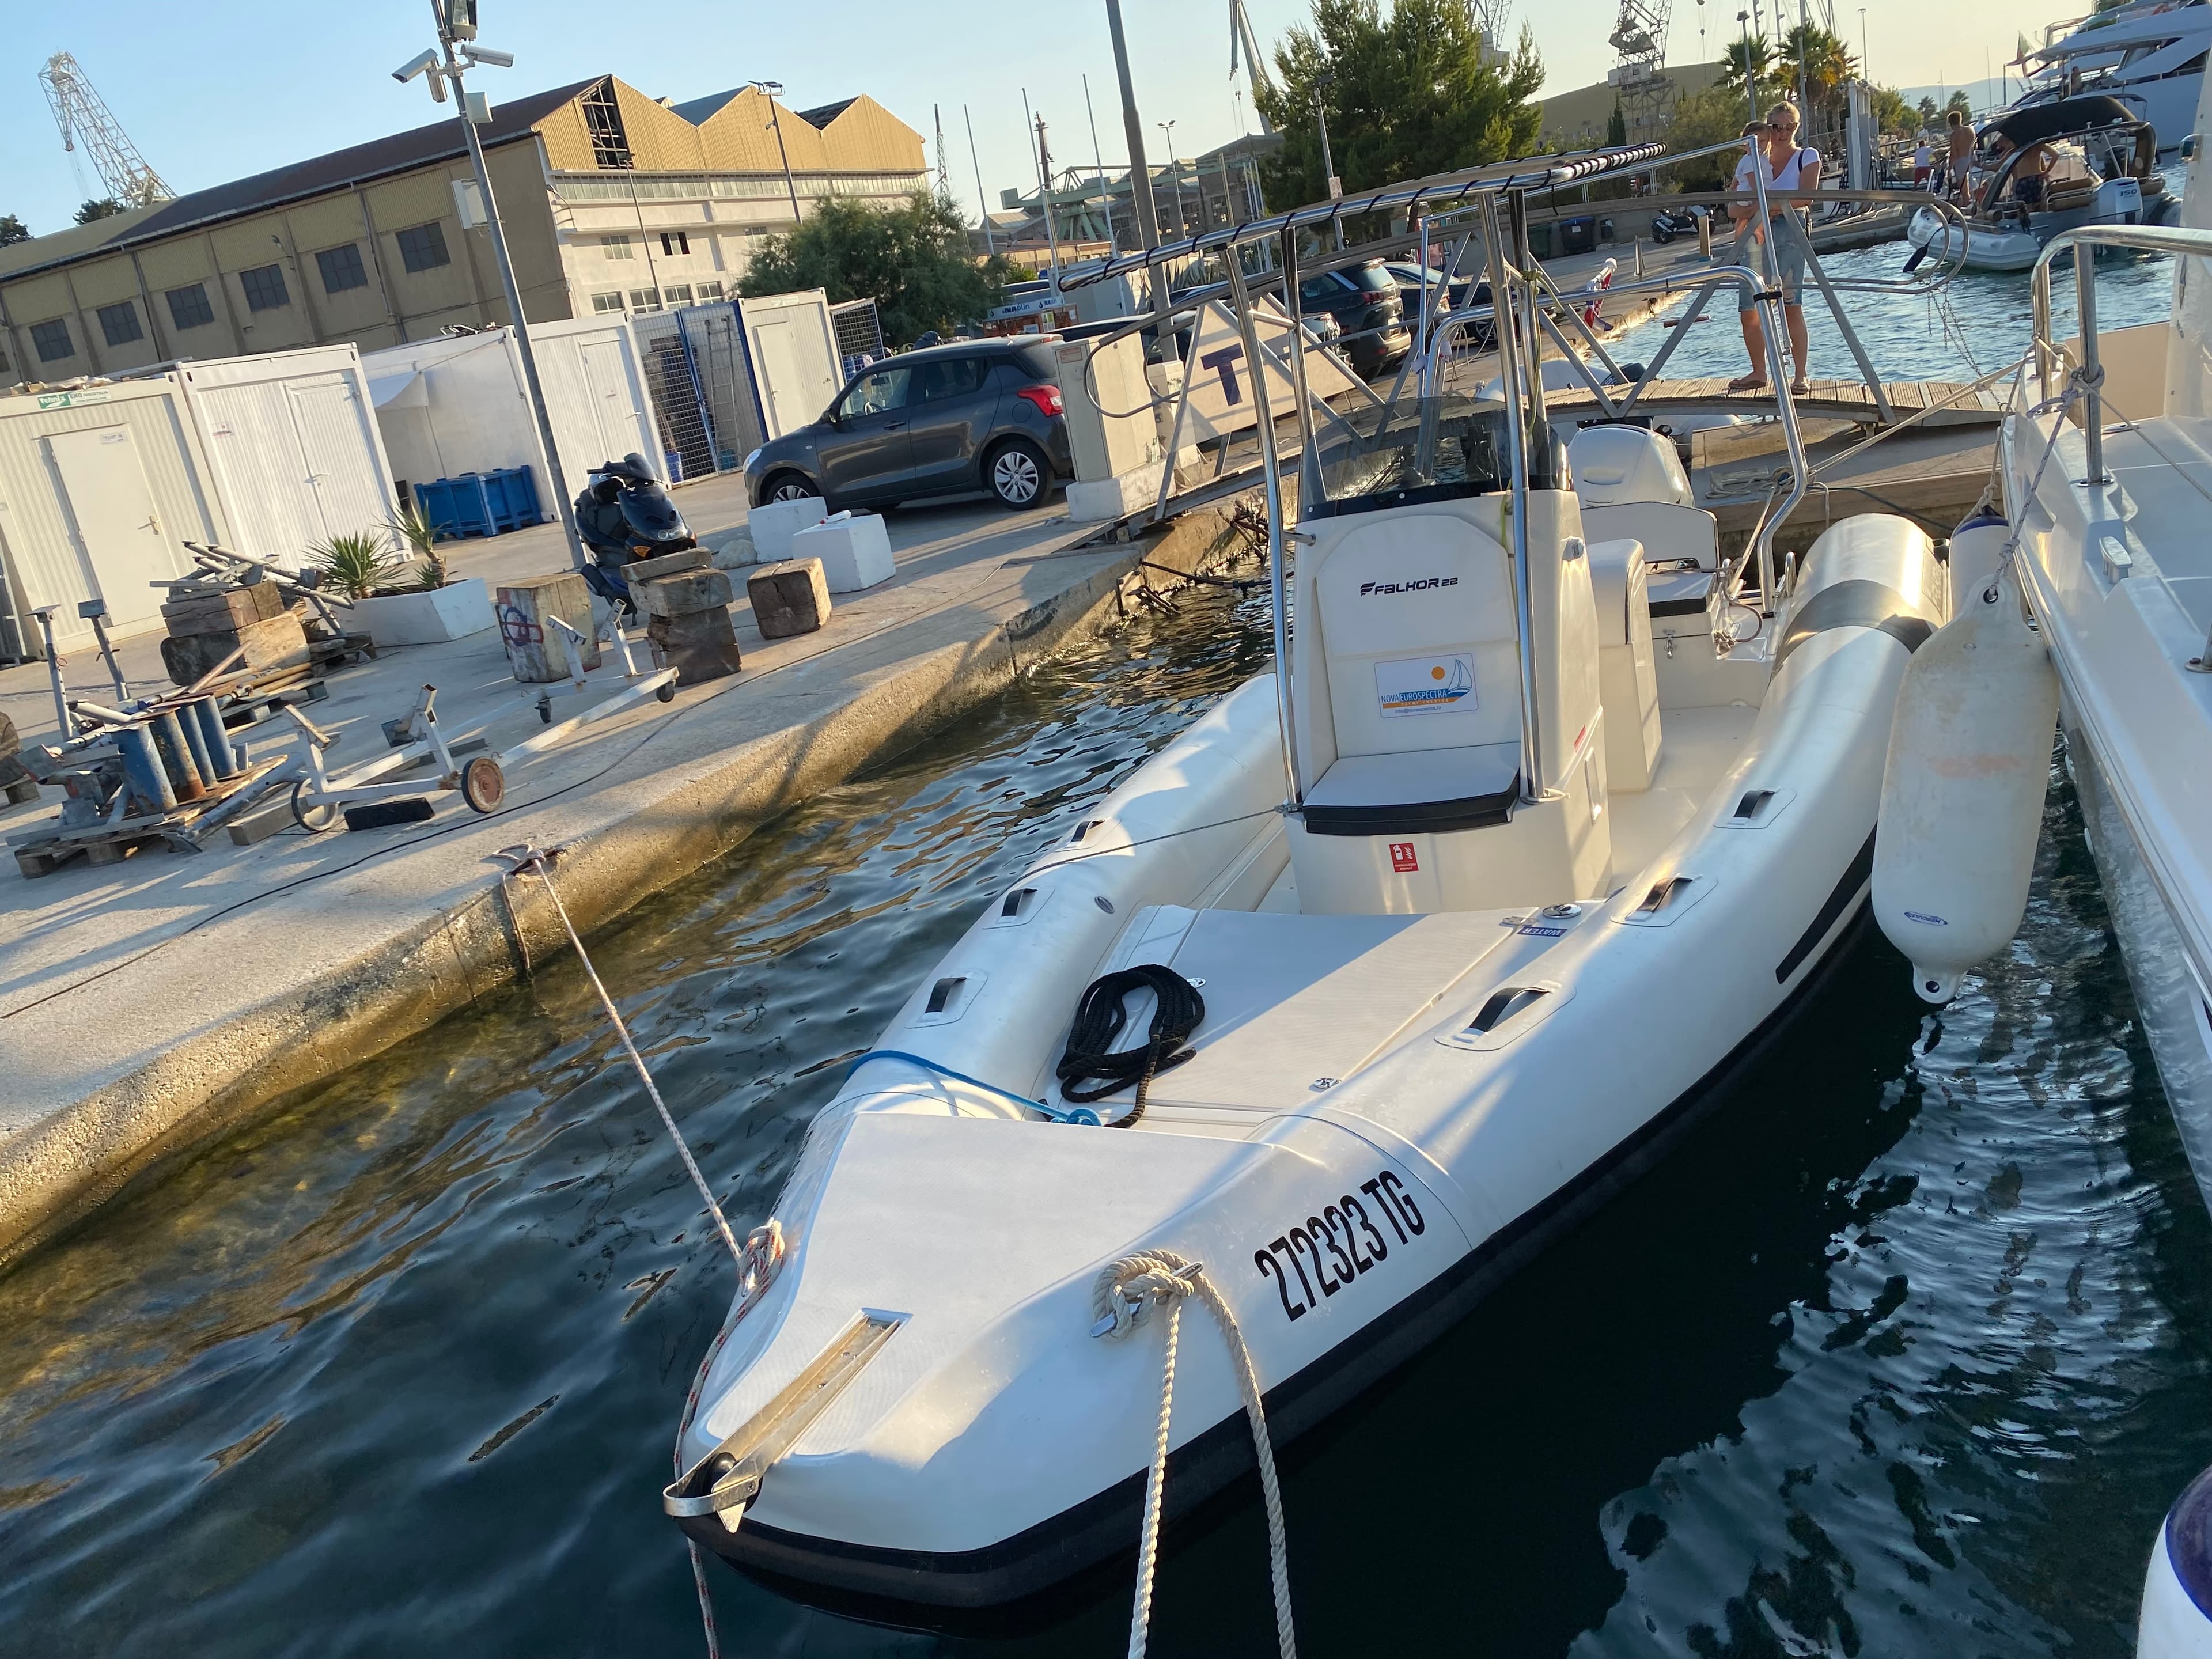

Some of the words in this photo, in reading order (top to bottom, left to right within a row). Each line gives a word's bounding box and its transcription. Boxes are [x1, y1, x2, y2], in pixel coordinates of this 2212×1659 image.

[2120, 188, 2137, 196] 150
[1200, 343, 1244, 407] T
[1441, 577, 1459, 586] 22
[1522, 927, 1562, 935] WATER
[1255, 1195, 1387, 1322] 272323
[1359, 1171, 1425, 1245] TG
